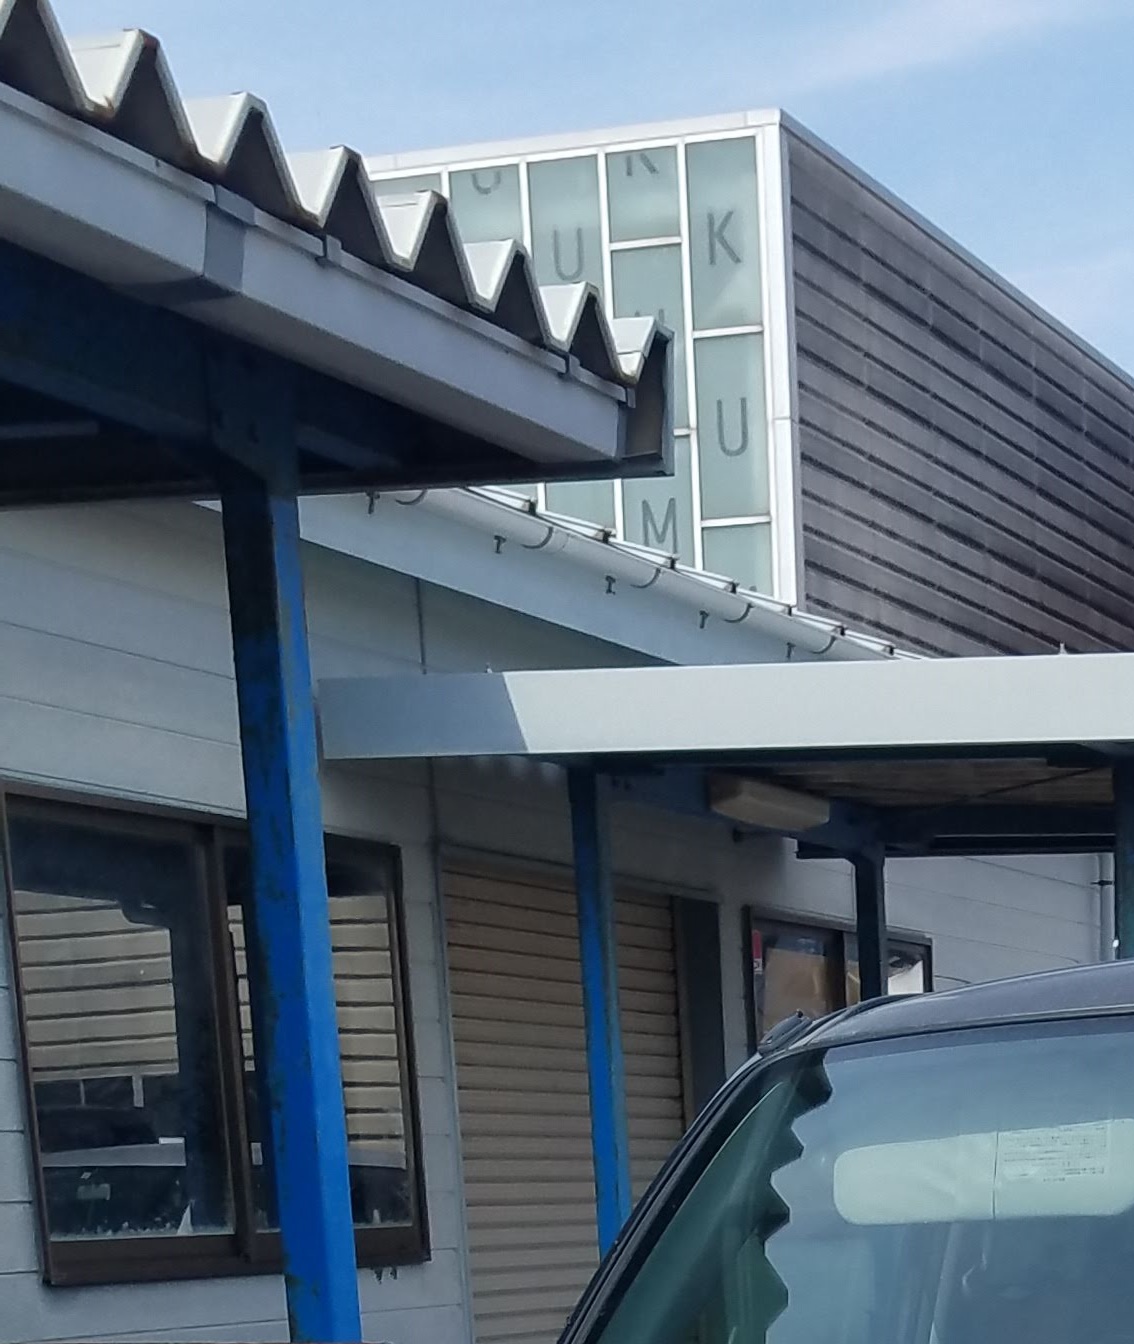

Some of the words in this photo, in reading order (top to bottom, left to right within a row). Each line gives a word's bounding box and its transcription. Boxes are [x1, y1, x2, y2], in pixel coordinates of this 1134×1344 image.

[553, 226, 585, 282] U
[706, 210, 743, 266] K
[716, 396, 749, 457] U
[641, 497, 678, 554] M
